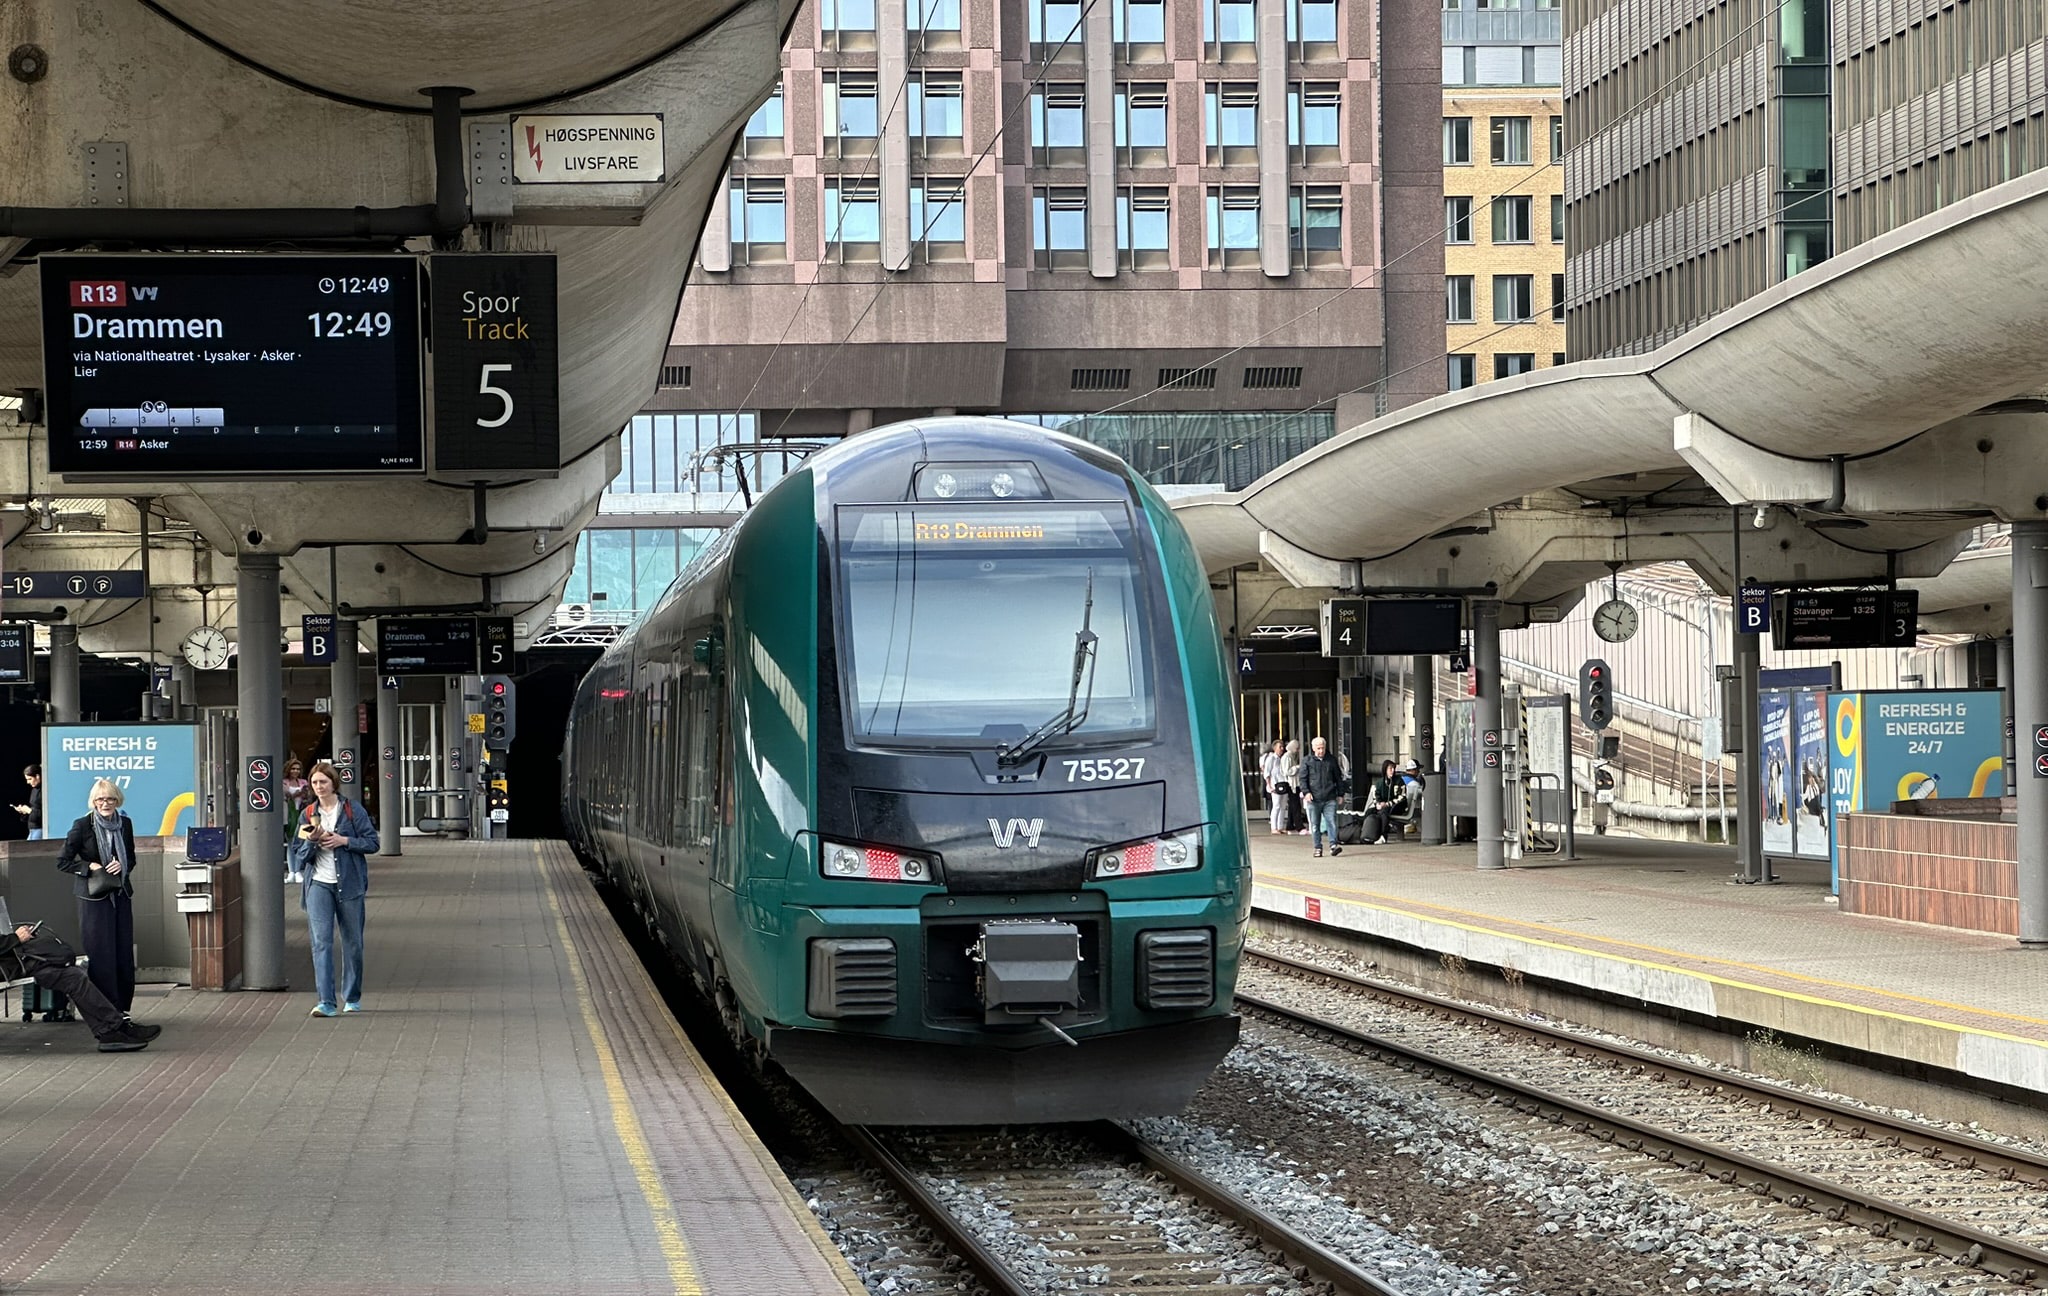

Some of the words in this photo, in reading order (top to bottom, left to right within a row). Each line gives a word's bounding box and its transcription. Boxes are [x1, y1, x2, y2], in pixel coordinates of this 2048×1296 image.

[545, 127, 656, 143] HØGSPENNING
[564, 155, 639, 171] LIVSFARE
[338, 277, 390, 294] 12:49
[462, 290, 520, 319] Spor
[73, 312, 223, 339] Drammen
[307, 311, 392, 338] 12:49
[462, 316, 529, 340] Track
[73, 350, 92, 361] via
[94, 350, 194, 362] Nationaltheatret
[204, 350, 250, 363] Lysaker
[260, 350, 295, 362] Asker
[74, 366, 98, 377] Lier
[476, 363, 514, 428] 5
[79, 440, 108, 450] 12:59
[139, 439, 169, 449] Asker
[916, 523, 950, 540] R13
[955, 522, 1044, 539] Drammen
[1741, 587, 1766, 596] Sektor
[1741, 596, 1766, 604] Sector
[1339, 608, 1355, 617] Spor
[1747, 606, 1761, 627] B
[1793, 607, 1834, 616] Stavanger
[1853, 605, 1876, 614] 13:25
[306, 616, 331, 625] Sektor
[1895, 619, 1906, 637] 3
[306, 625, 331, 633] Sector
[487, 625, 504, 635] Spor
[1339, 627, 1352, 646] 4
[312, 635, 327, 656] B
[491, 644, 503, 664] 5
[1241, 658, 1252, 671] A
[1879, 703, 1951, 718] REFRESH
[1955, 703, 1967, 717] &
[1885, 721, 1966, 736] ENERGIZE
[62, 736, 141, 752] REFRESH
[145, 736, 158, 751] &
[1908, 741, 1943, 754] 24/7
[69, 755, 156, 771] ENERGIZE
[1063, 757, 1146, 783] 75527
[1832, 767, 1853, 795] JOY
